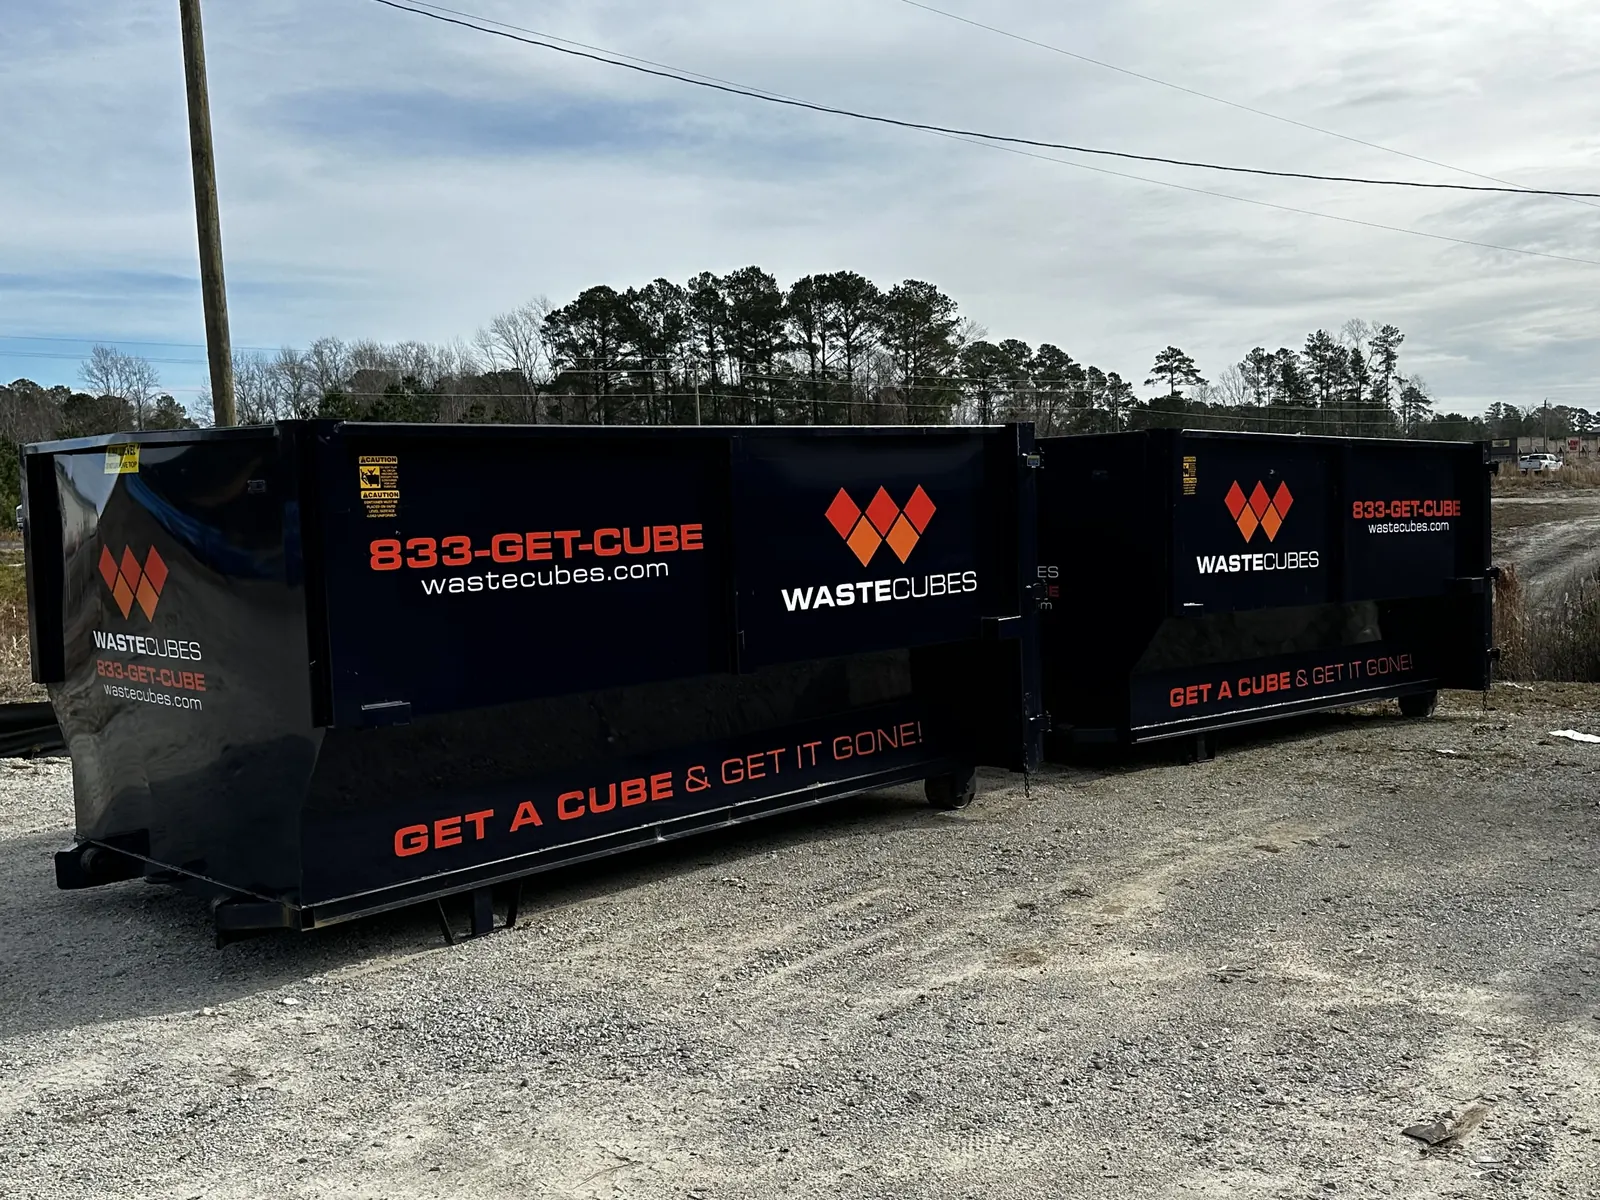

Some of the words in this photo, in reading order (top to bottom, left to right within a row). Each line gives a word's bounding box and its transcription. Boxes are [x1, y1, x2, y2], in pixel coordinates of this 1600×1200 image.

[1353, 500, 1461, 519] 833-GET-CUBE
[1368, 520, 1450, 534] wastecubes.com
[370, 523, 704, 571] 833-GET-CUBE
[1196, 551, 1320, 574] WASTECUBES
[421, 562, 669, 595] wastecubes.com
[781, 570, 977, 612] WASTECUBES
[93, 630, 202, 661] WASTECUBES
[97, 659, 207, 692] 833-GET-CUBE
[1169, 683, 1213, 708] GET
[1217, 681, 1233, 700] A
[1238, 671, 1291, 697] CUBE
[1295, 669, 1308, 688] &
[1312, 663, 1345, 685] GET
[1349, 660, 1363, 680] IT
[1366, 653, 1413, 677] GONE!
[103, 683, 203, 711] wastecubes.com
[394, 808, 495, 857] GET
[509, 801, 543, 832] A
[557, 772, 674, 820] CUBE
[685, 765, 712, 793] &
[721, 748, 786, 784] GET
[797, 741, 823, 769] IT
[833, 721, 923, 761] GONE!
